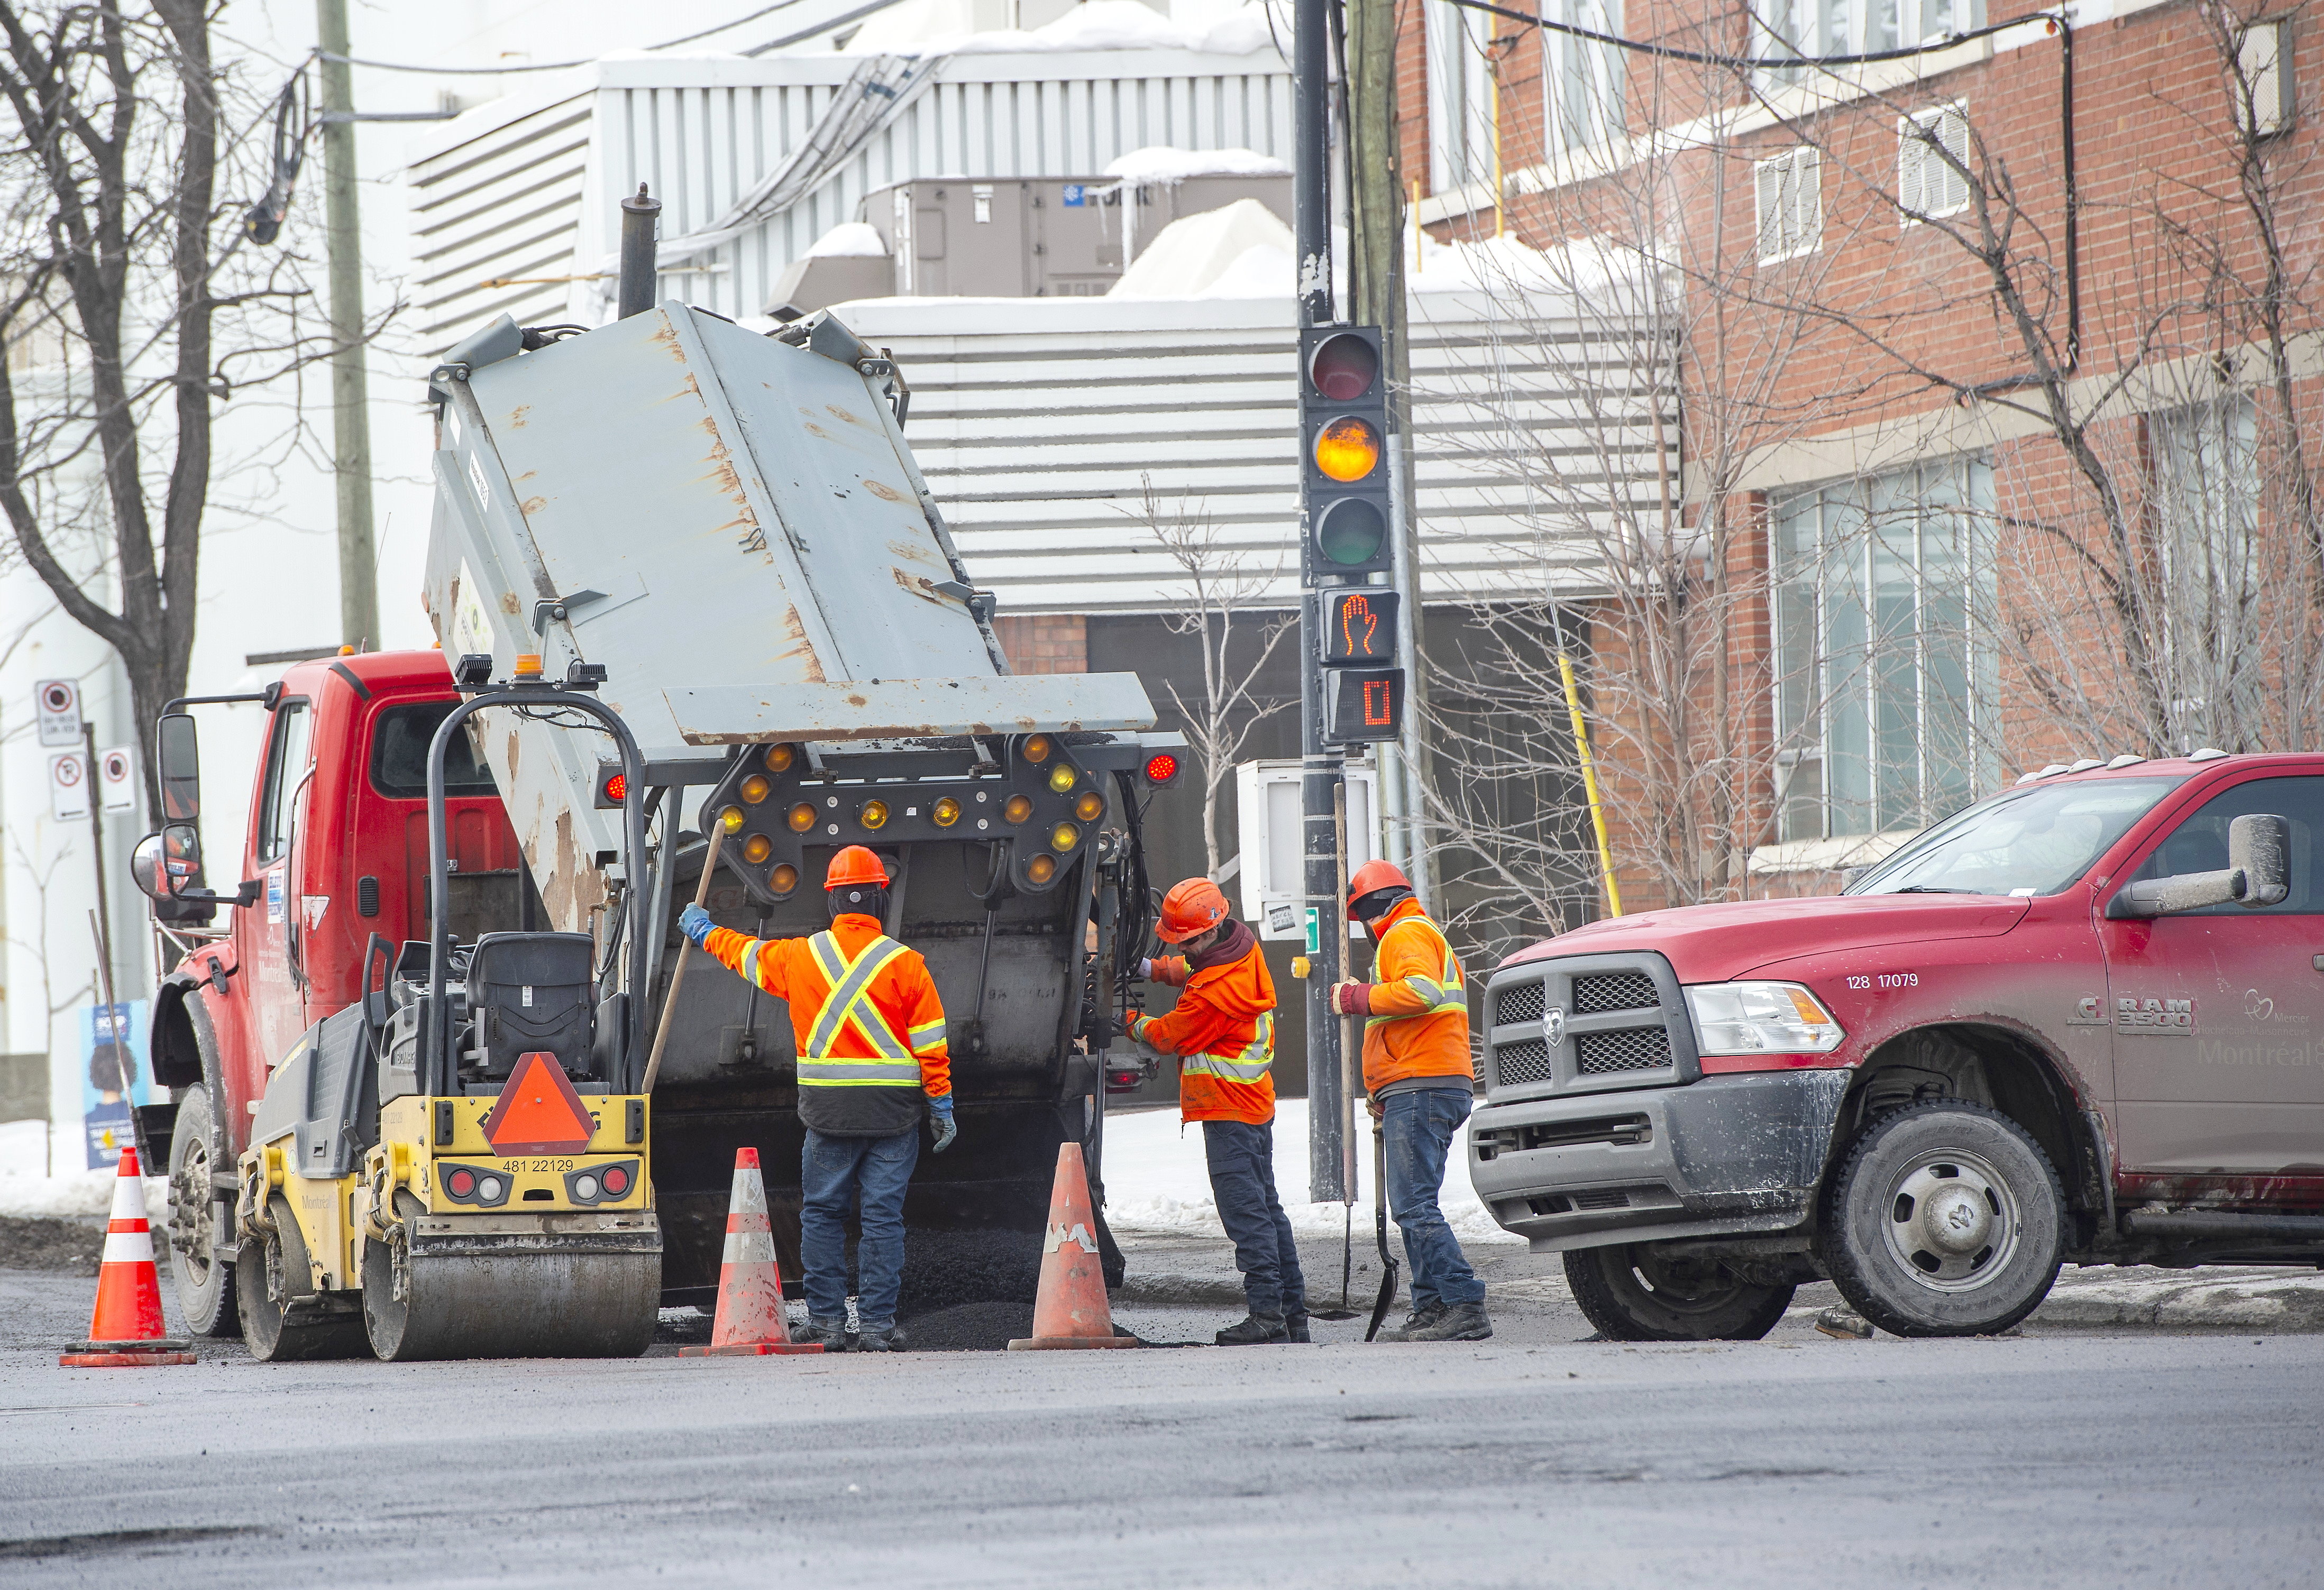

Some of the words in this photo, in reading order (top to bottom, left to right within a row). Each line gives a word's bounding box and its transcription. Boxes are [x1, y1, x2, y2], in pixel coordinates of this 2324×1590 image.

[1364, 681, 1390, 725] 0
[1846, 976, 1870, 989] 128
[1878, 973, 1918, 987] 17079
[2118, 998, 2192, 1013] RAM
[2118, 1012, 2192, 1027] 3500
[2275, 1012, 2310, 1023] Mercier
[2198, 1039, 2310, 1066] Montréal
[502, 1160, 526, 1172] 481
[532, 1160, 573, 1172] 22129
